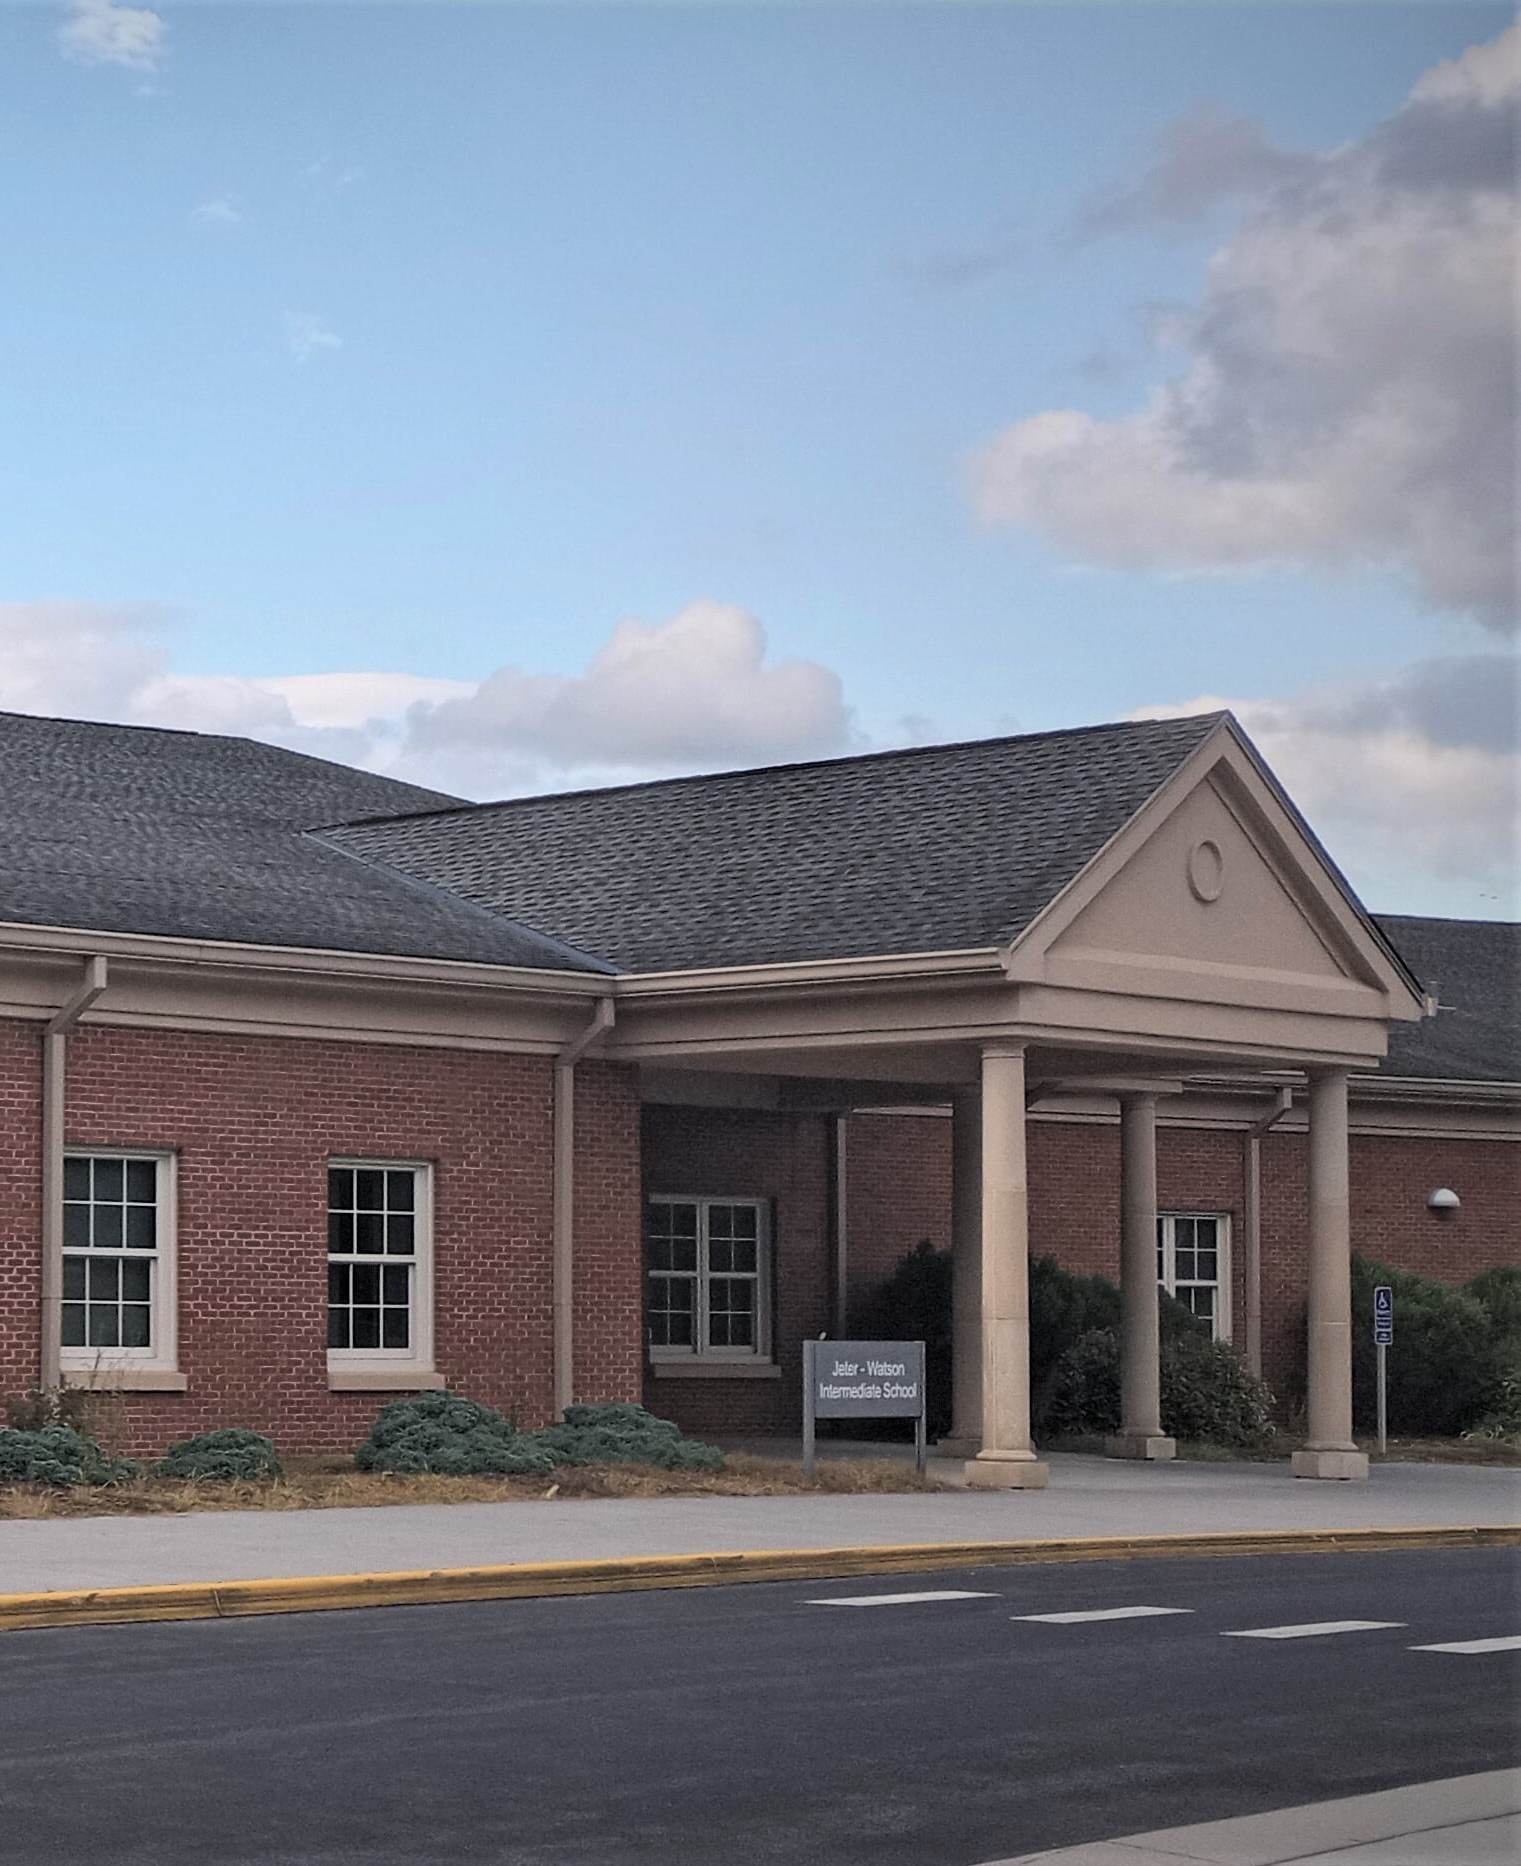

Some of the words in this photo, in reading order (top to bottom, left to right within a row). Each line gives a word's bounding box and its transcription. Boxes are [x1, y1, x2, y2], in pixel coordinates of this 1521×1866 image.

[832, 1360, 859, 1376] Jeter
[866, 1360, 905, 1376] Watson
[819, 1382, 882, 1399] Intermediate
[882, 1381, 917, 1398] School
